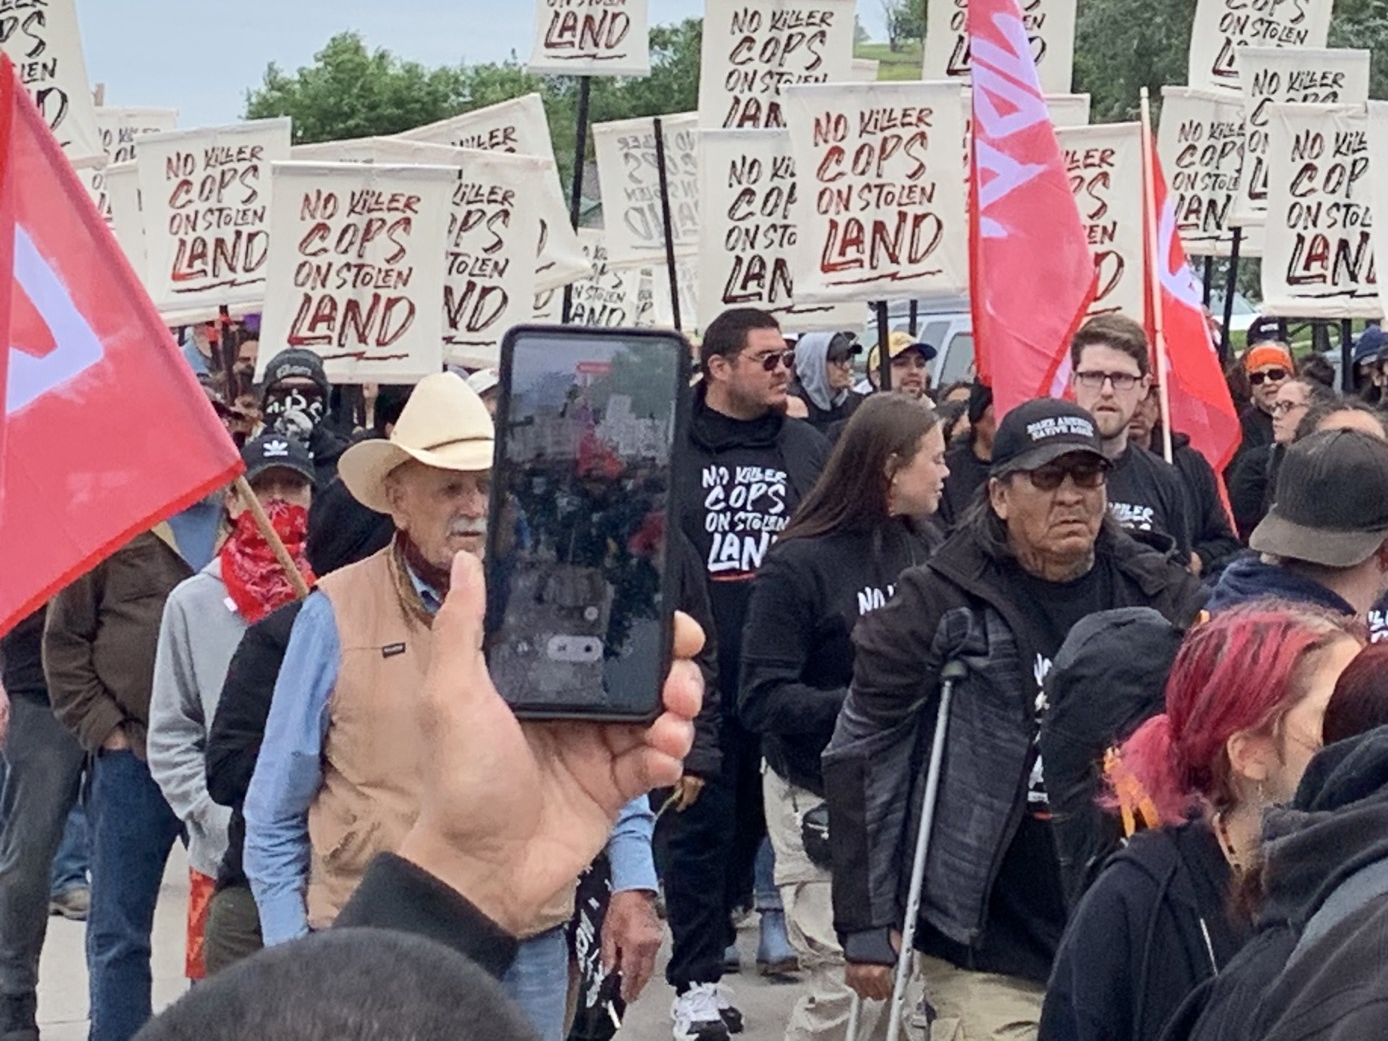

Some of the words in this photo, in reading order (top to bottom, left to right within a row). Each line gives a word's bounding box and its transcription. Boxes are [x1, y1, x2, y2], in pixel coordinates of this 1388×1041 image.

[544, 9, 630, 50] LAND
[731, 7, 762, 35] NO
[1219, 12, 1249, 35] ON
[1251, 19, 1308, 45] STOLEN
[729, 30, 826, 71] COPS
[725, 69, 757, 93] ON
[1251, 69, 1280, 97] NO
[814, 112, 848, 147] NO
[1178, 119, 1202, 143] NO
[1291, 129, 1325, 162] NO
[166, 151, 195, 179] NO
[729, 155, 761, 187] NO
[816, 131, 928, 182] COPS
[169, 164, 259, 209] COPS
[1172, 172, 1198, 191] ON
[1289, 157, 1369, 198] COP
[300, 189, 338, 221] NO
[728, 183, 798, 221] COP
[817, 184, 852, 215] ON
[858, 182, 935, 211] STOLEN
[1174, 193, 1232, 232] LAN
[169, 210, 199, 236] ON
[202, 206, 267, 231] STOLEN
[1287, 201, 1322, 230] ON
[1327, 202, 1373, 228] STOL
[299, 217, 411, 264] COPS
[725, 224, 759, 251] ON
[763, 225, 797, 249] STO
[820, 210, 943, 273] LAND
[171, 230, 269, 281] LAND
[1285, 230, 1377, 286] LAN
[294, 261, 332, 290] ON
[336, 262, 412, 289] STOLEN
[722, 255, 793, 304] LAN
[287, 292, 416, 348] LAND
[444, 280, 508, 332] ND
[571, 302, 626, 326] AND
[702, 465, 729, 488] NO
[705, 483, 786, 513] COPS
[705, 511, 731, 532] ON
[734, 512, 790, 532] STOLEN
[707, 532, 778, 572] LAN
